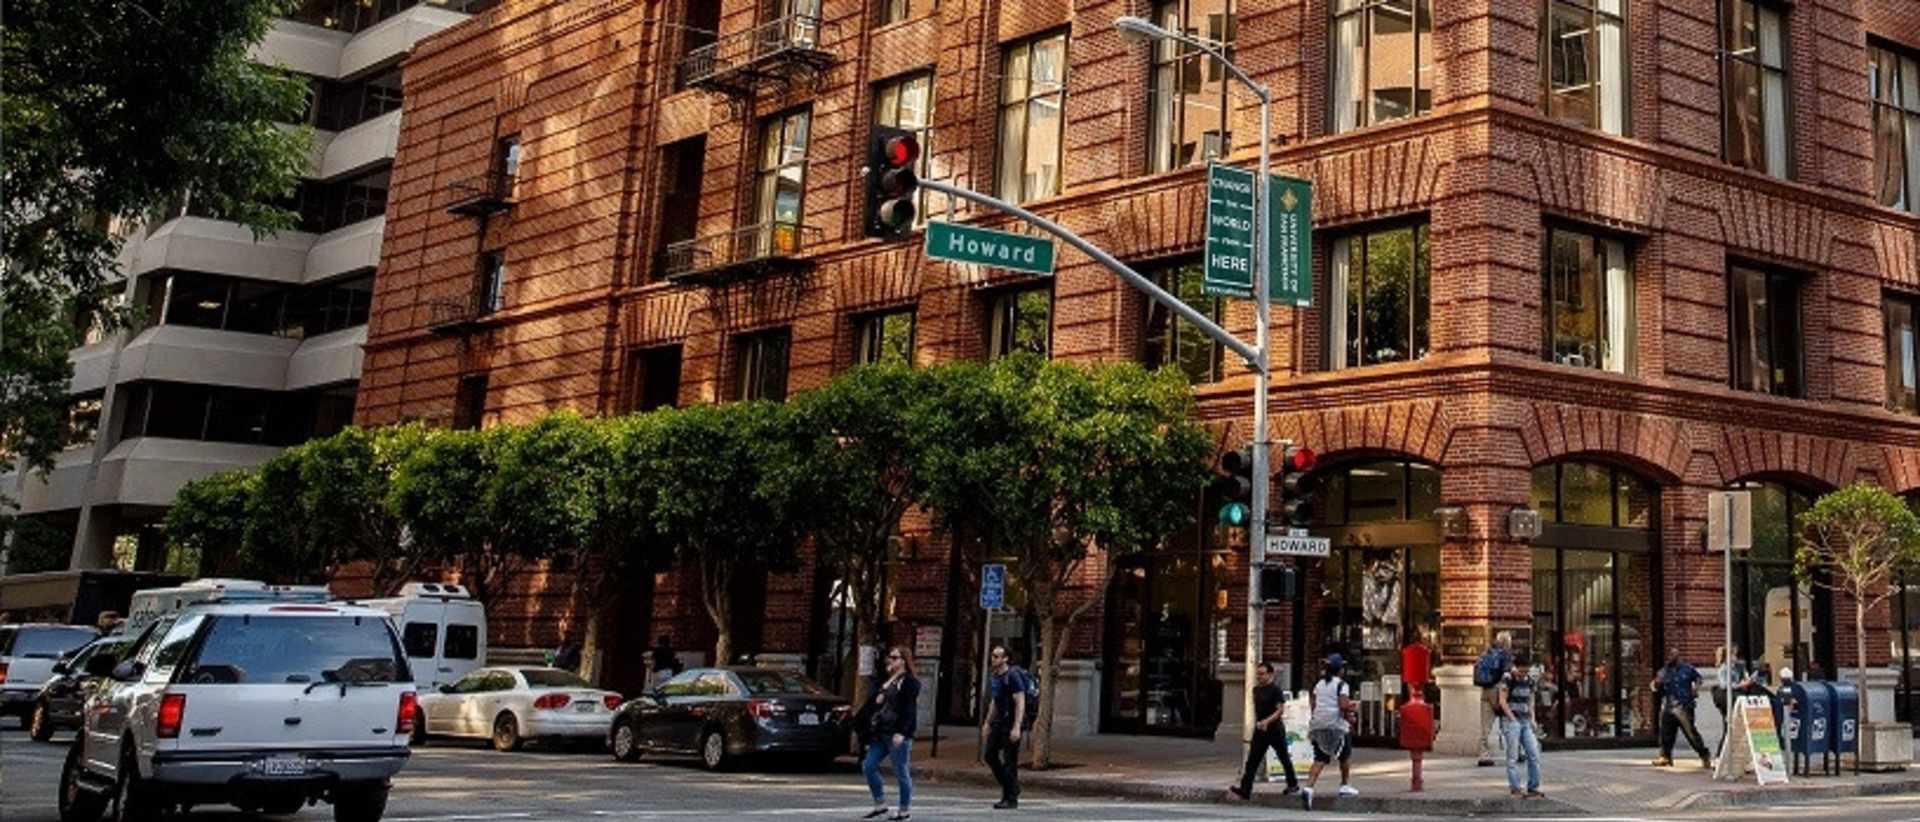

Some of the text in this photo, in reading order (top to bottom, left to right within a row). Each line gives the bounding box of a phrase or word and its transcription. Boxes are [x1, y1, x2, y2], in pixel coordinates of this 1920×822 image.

[1212, 178, 1251, 194] CHANGE
[1212, 214, 1251, 231] WORLD
[1280, 213, 1289, 234] SAN
[949, 232, 1035, 263] Howard
[1289, 213, 1298, 293] UNIVERSITY OF
[1211, 253, 1249, 273] HERE
[1271, 539, 1326, 553] HOWARD
